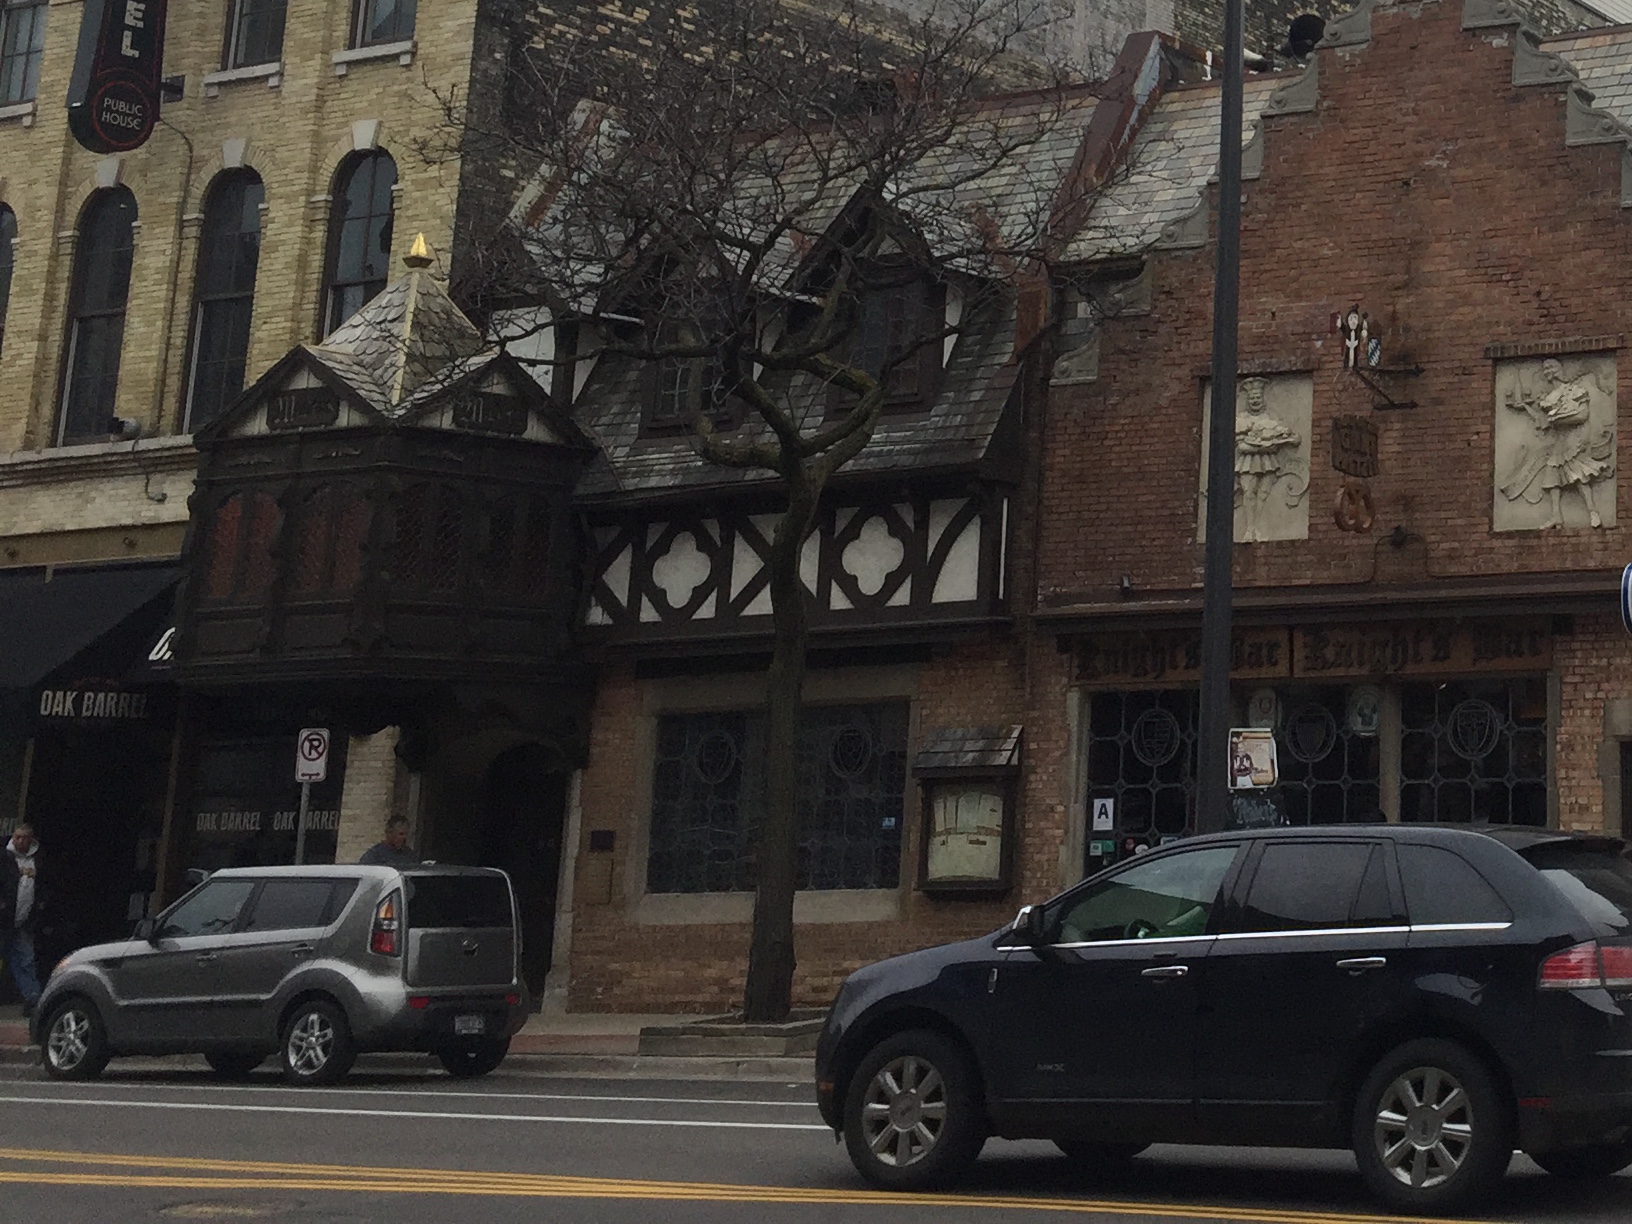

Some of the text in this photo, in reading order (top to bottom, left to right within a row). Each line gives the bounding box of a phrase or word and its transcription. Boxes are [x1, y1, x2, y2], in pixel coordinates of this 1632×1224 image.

[103, 97, 143, 116] PUBLIC
[101, 111, 142, 130] HOUSE
[40, 690, 148, 719] OAK BARREL
[274, 810, 340, 831] OAK ARREL
[1098, 803, 1109, 819] A
